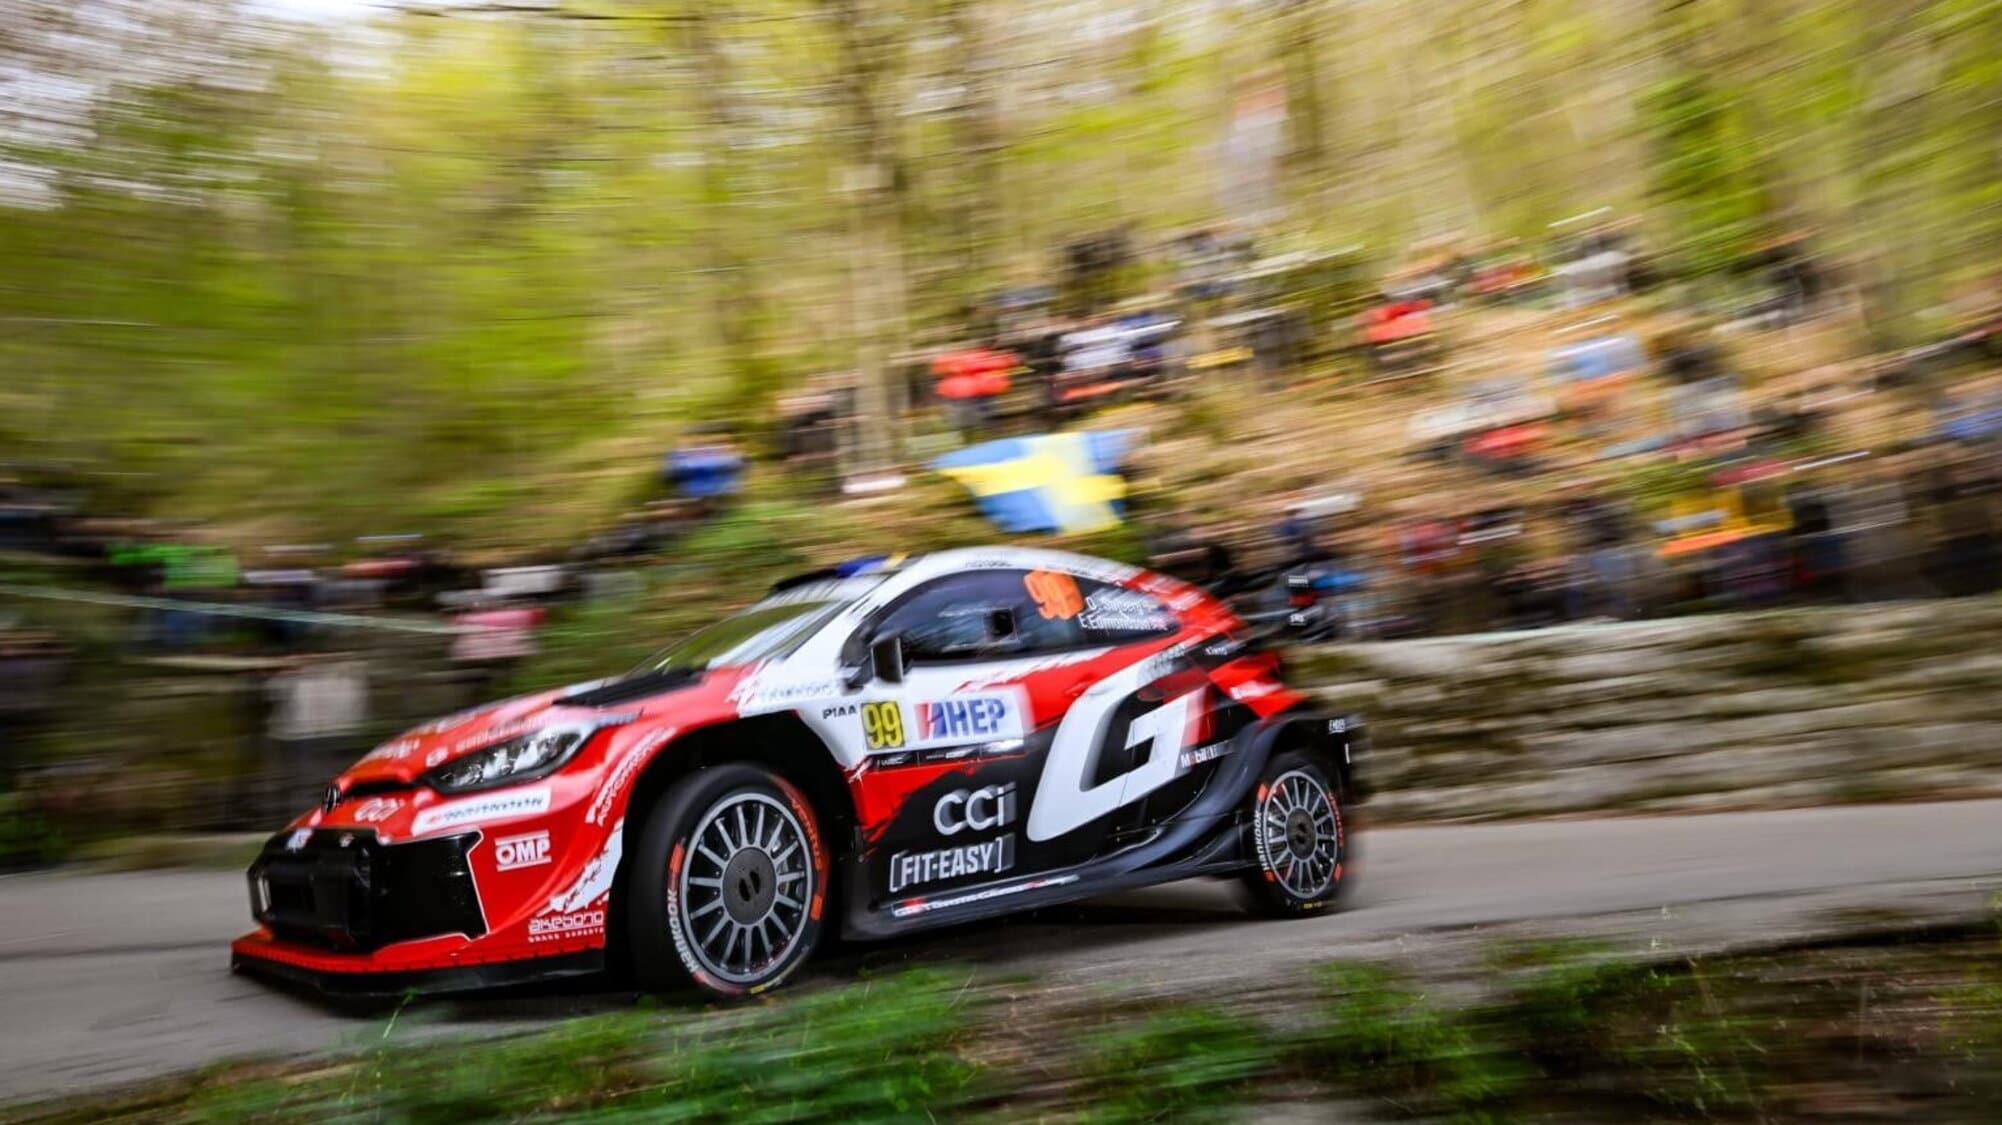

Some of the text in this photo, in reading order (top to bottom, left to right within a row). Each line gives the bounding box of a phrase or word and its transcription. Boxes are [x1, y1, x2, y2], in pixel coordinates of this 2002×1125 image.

[822, 702, 857, 720] PIAA
[864, 702, 904, 749] 99
[496, 838, 551, 867] OMP
